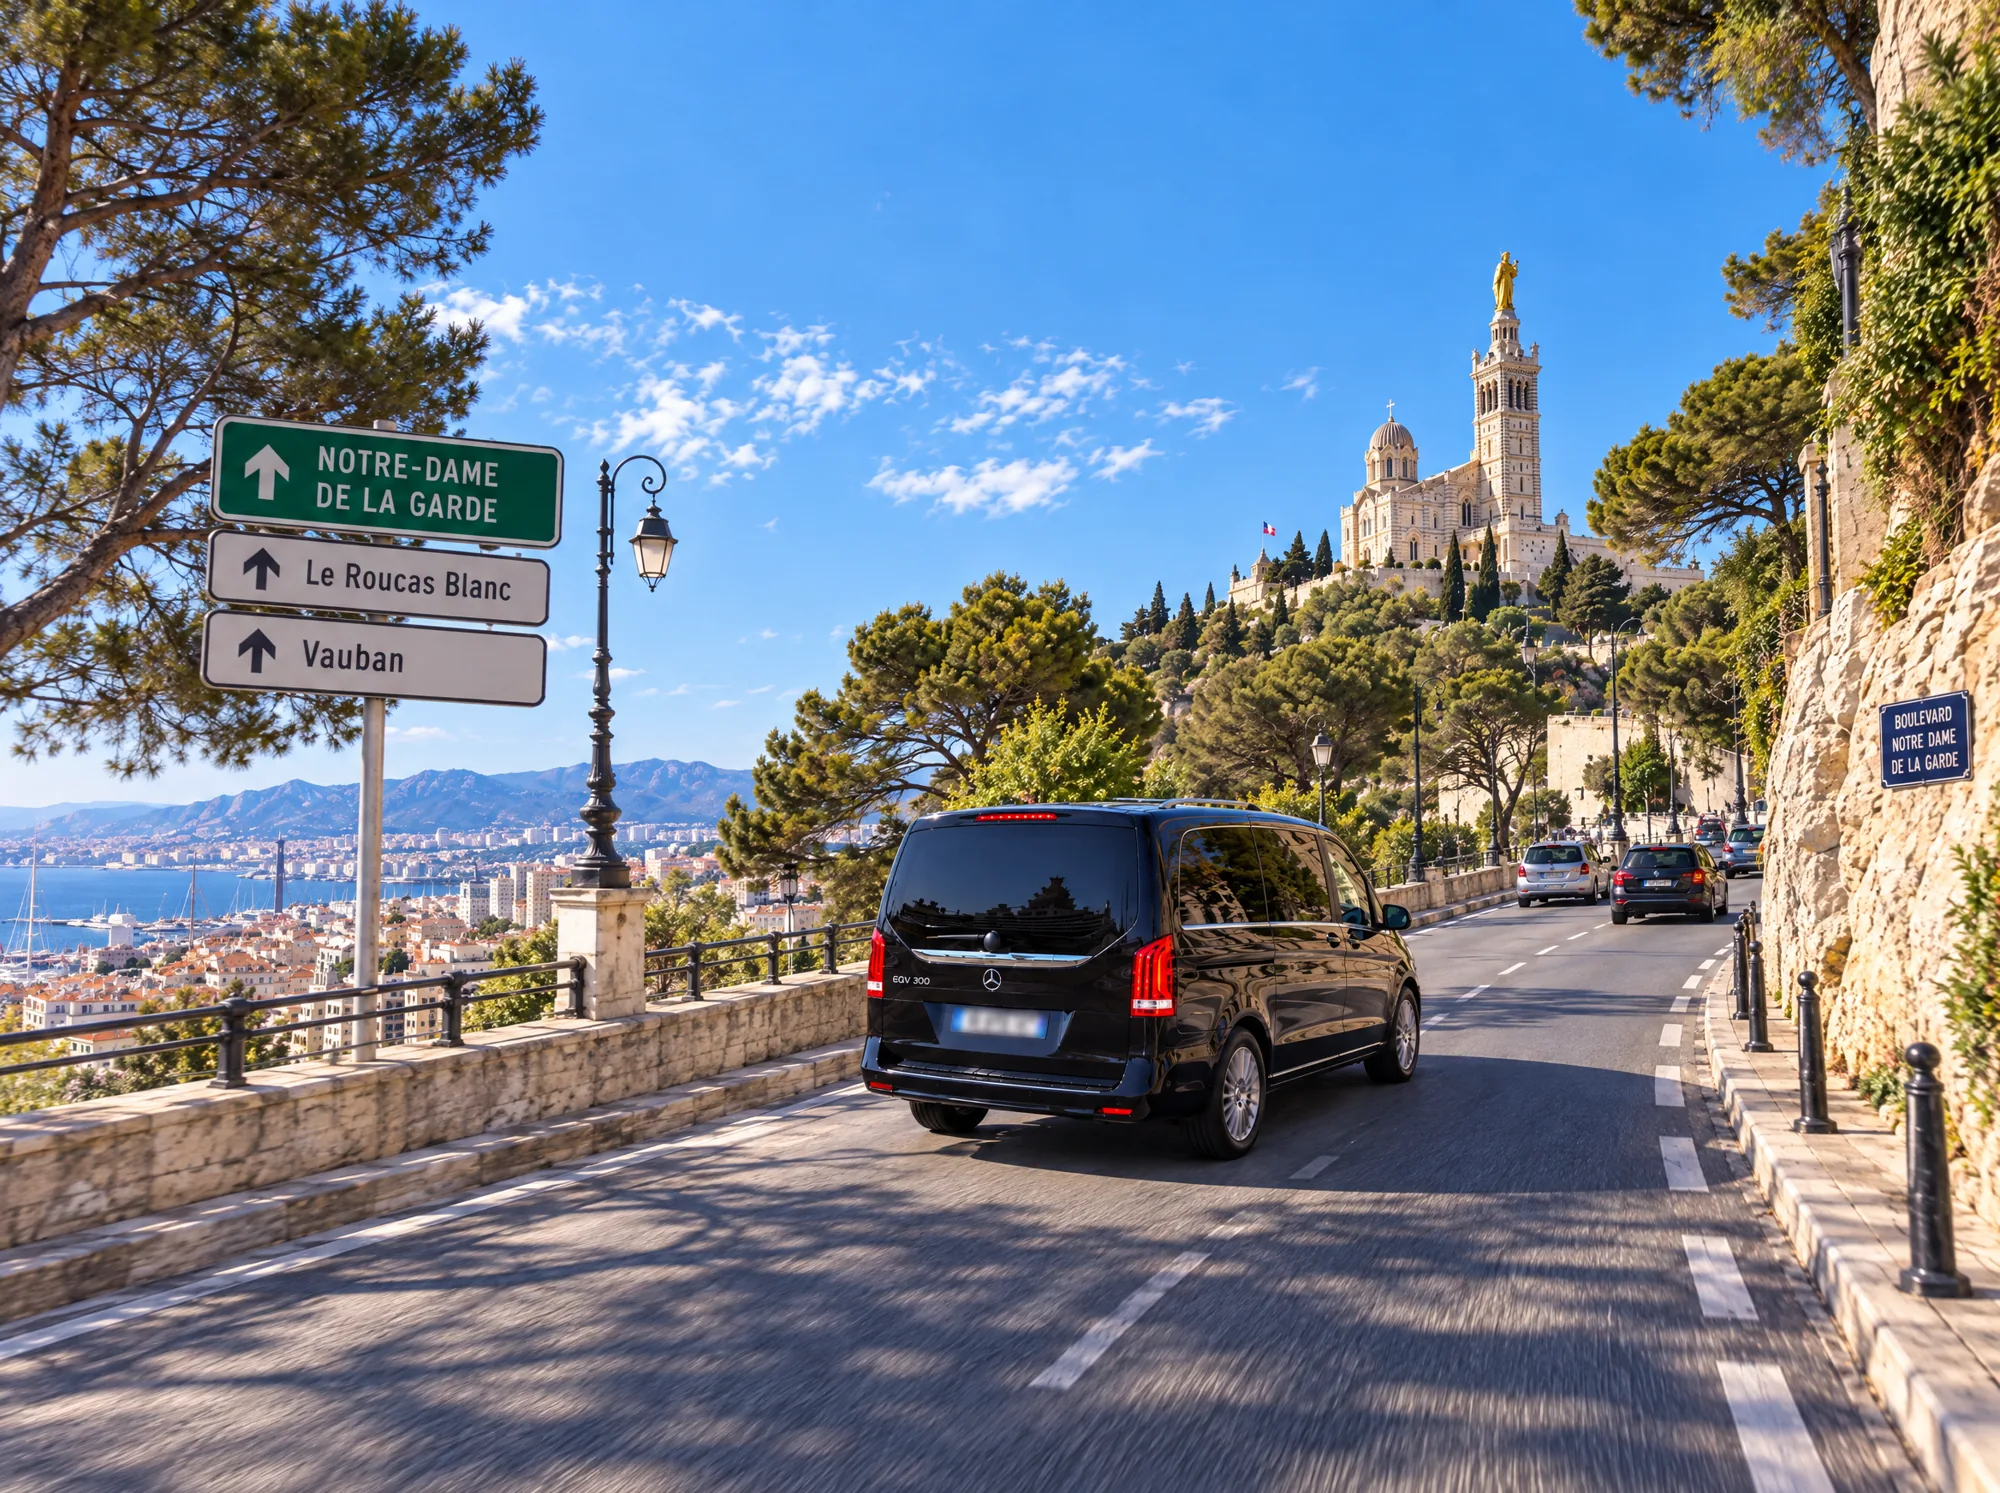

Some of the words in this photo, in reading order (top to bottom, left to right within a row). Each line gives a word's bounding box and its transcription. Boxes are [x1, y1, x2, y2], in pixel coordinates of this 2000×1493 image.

[318, 445, 499, 487] NOTRE-DAME
[317, 482, 351, 511] DE
[363, 487, 396, 515] LA
[410, 491, 498, 524] GARDE
[306, 559, 335, 587] Le
[345, 563, 435, 595] Roucas
[445, 571, 511, 602] Blanc
[302, 639, 404, 673] Vauban
[1894, 705, 1953, 730] BOULEVARD
[1892, 733, 1924, 753] NOTRE
[1928, 728, 1957, 747] DAME
[1891, 758, 1904, 775] DE
[1907, 757, 1921, 773] LA
[1925, 752, 1959, 771] GARDE
[892, 975, 911, 984] EQV
[912, 977, 931, 986] 300
